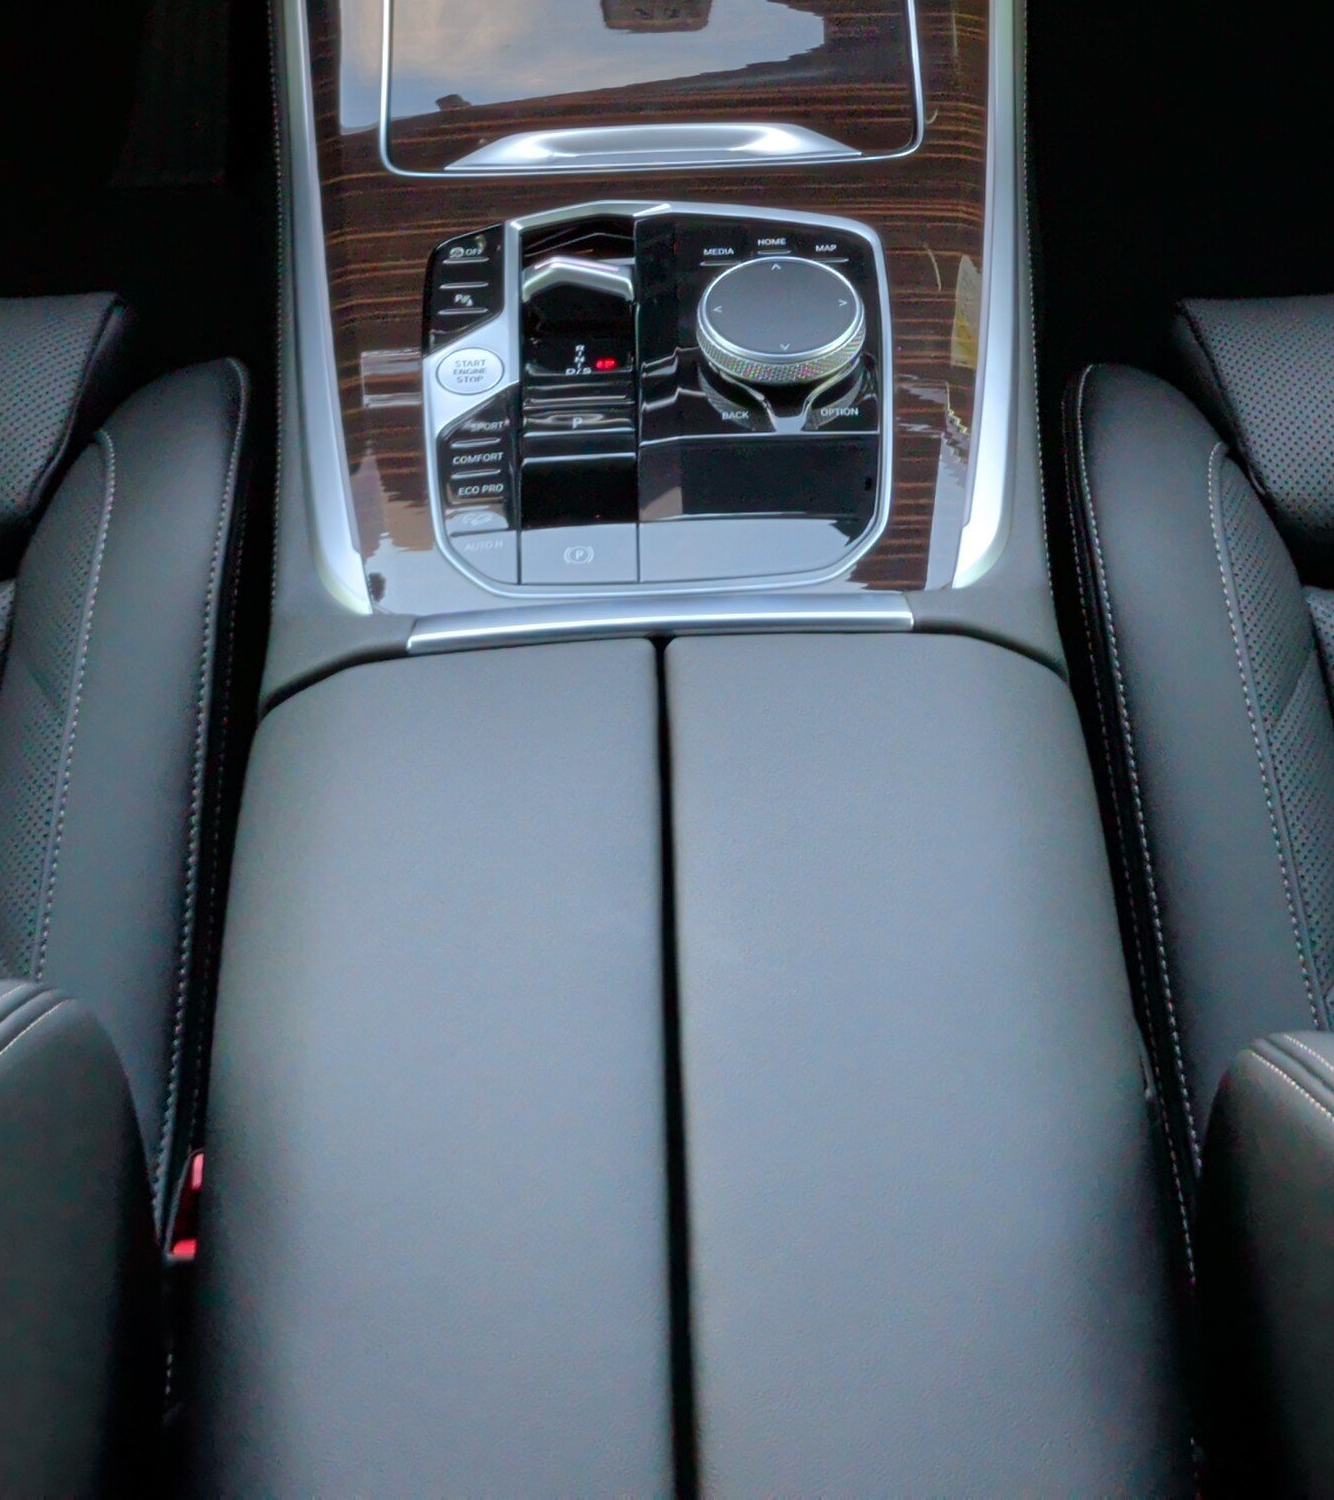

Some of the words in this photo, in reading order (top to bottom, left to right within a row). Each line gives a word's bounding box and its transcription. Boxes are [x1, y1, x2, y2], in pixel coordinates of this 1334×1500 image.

[757, 238, 786, 246] HOME
[703, 247, 734, 256] MEDIA
[815, 244, 837, 252] MAP
[456, 376, 484, 384] STOP
[722, 411, 749, 420] BACK
[820, 407, 859, 417] OPTION
[470, 421, 504, 432] SPORT
[572, 418, 584, 428] P
[452, 452, 504, 465] COMFORT
[458, 486, 480, 496] ECO
[481, 483, 504, 494] PRO
[464, 541, 492, 551] AUTO
